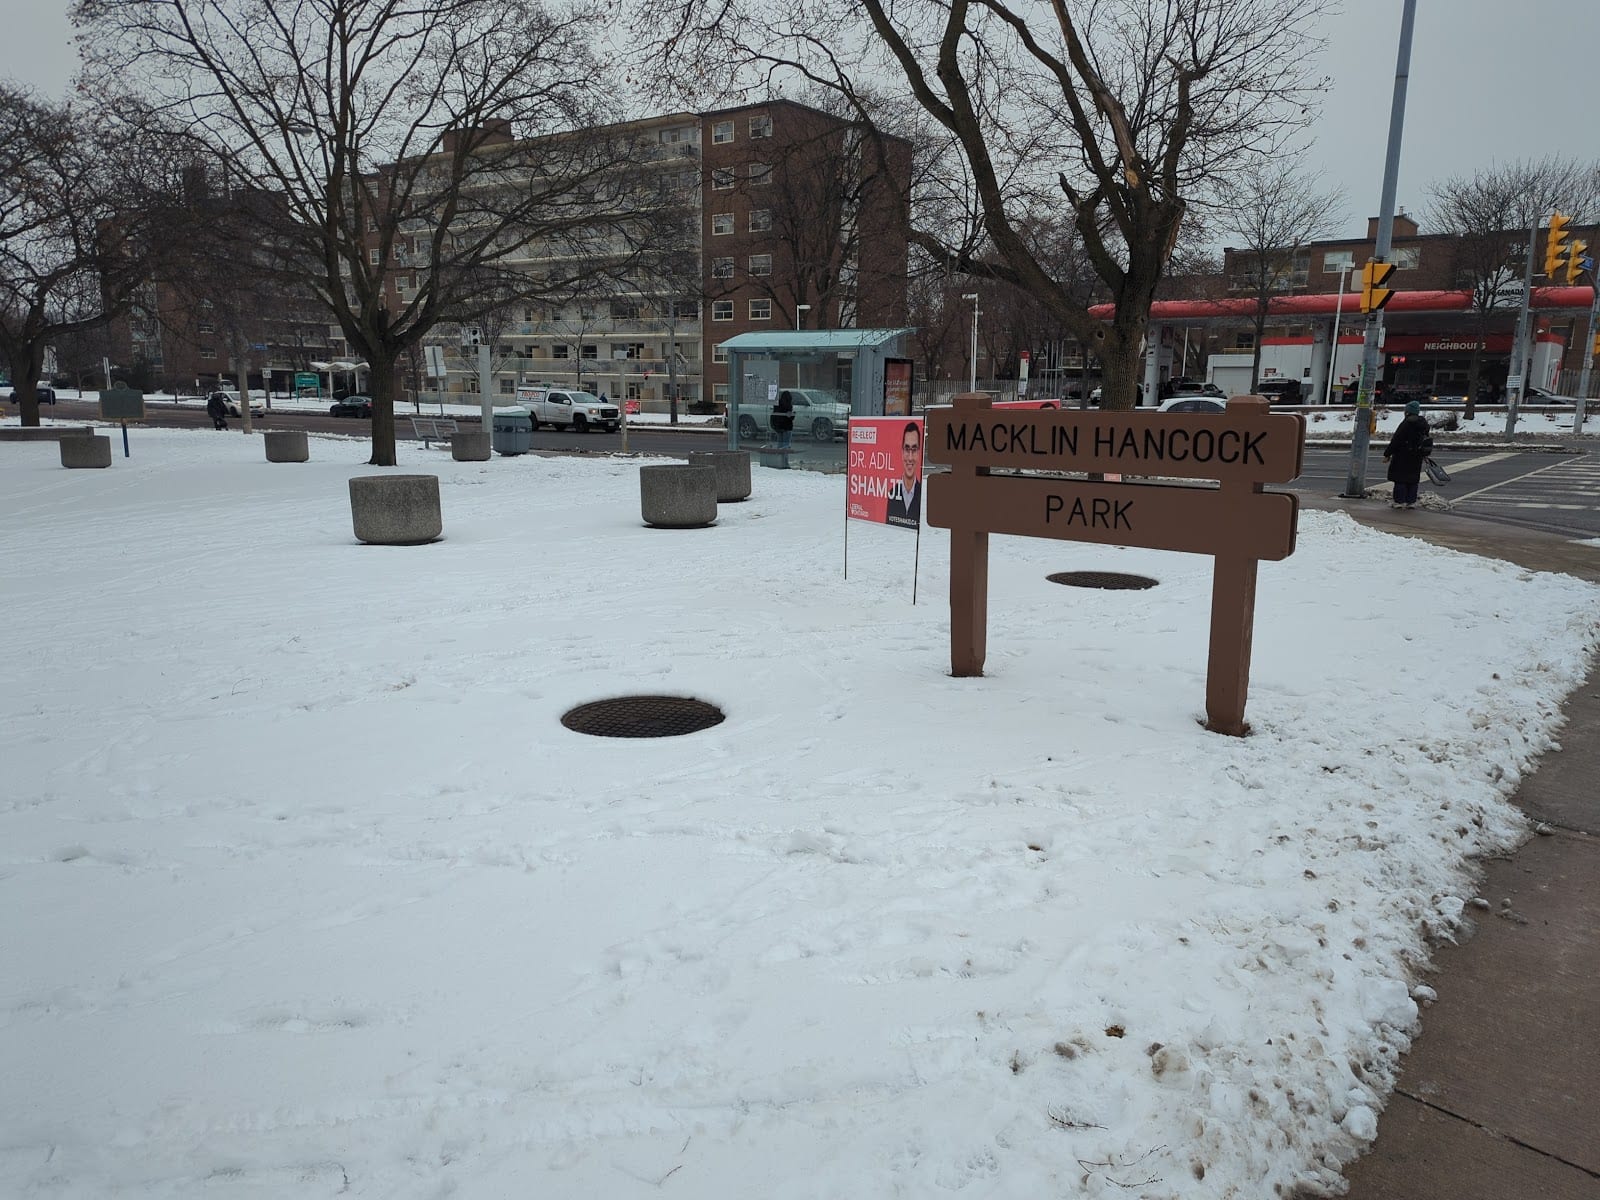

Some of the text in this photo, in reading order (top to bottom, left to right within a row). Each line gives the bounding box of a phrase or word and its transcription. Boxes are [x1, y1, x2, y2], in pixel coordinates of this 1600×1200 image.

[852, 430, 876, 440] RE-ELECT
[946, 422, 1268, 465] MACKLIN HANCOCK
[850, 450, 895, 471] DR. ADIL
[850, 474, 903, 501] SHAMJI
[1045, 495, 1133, 531] PARK
